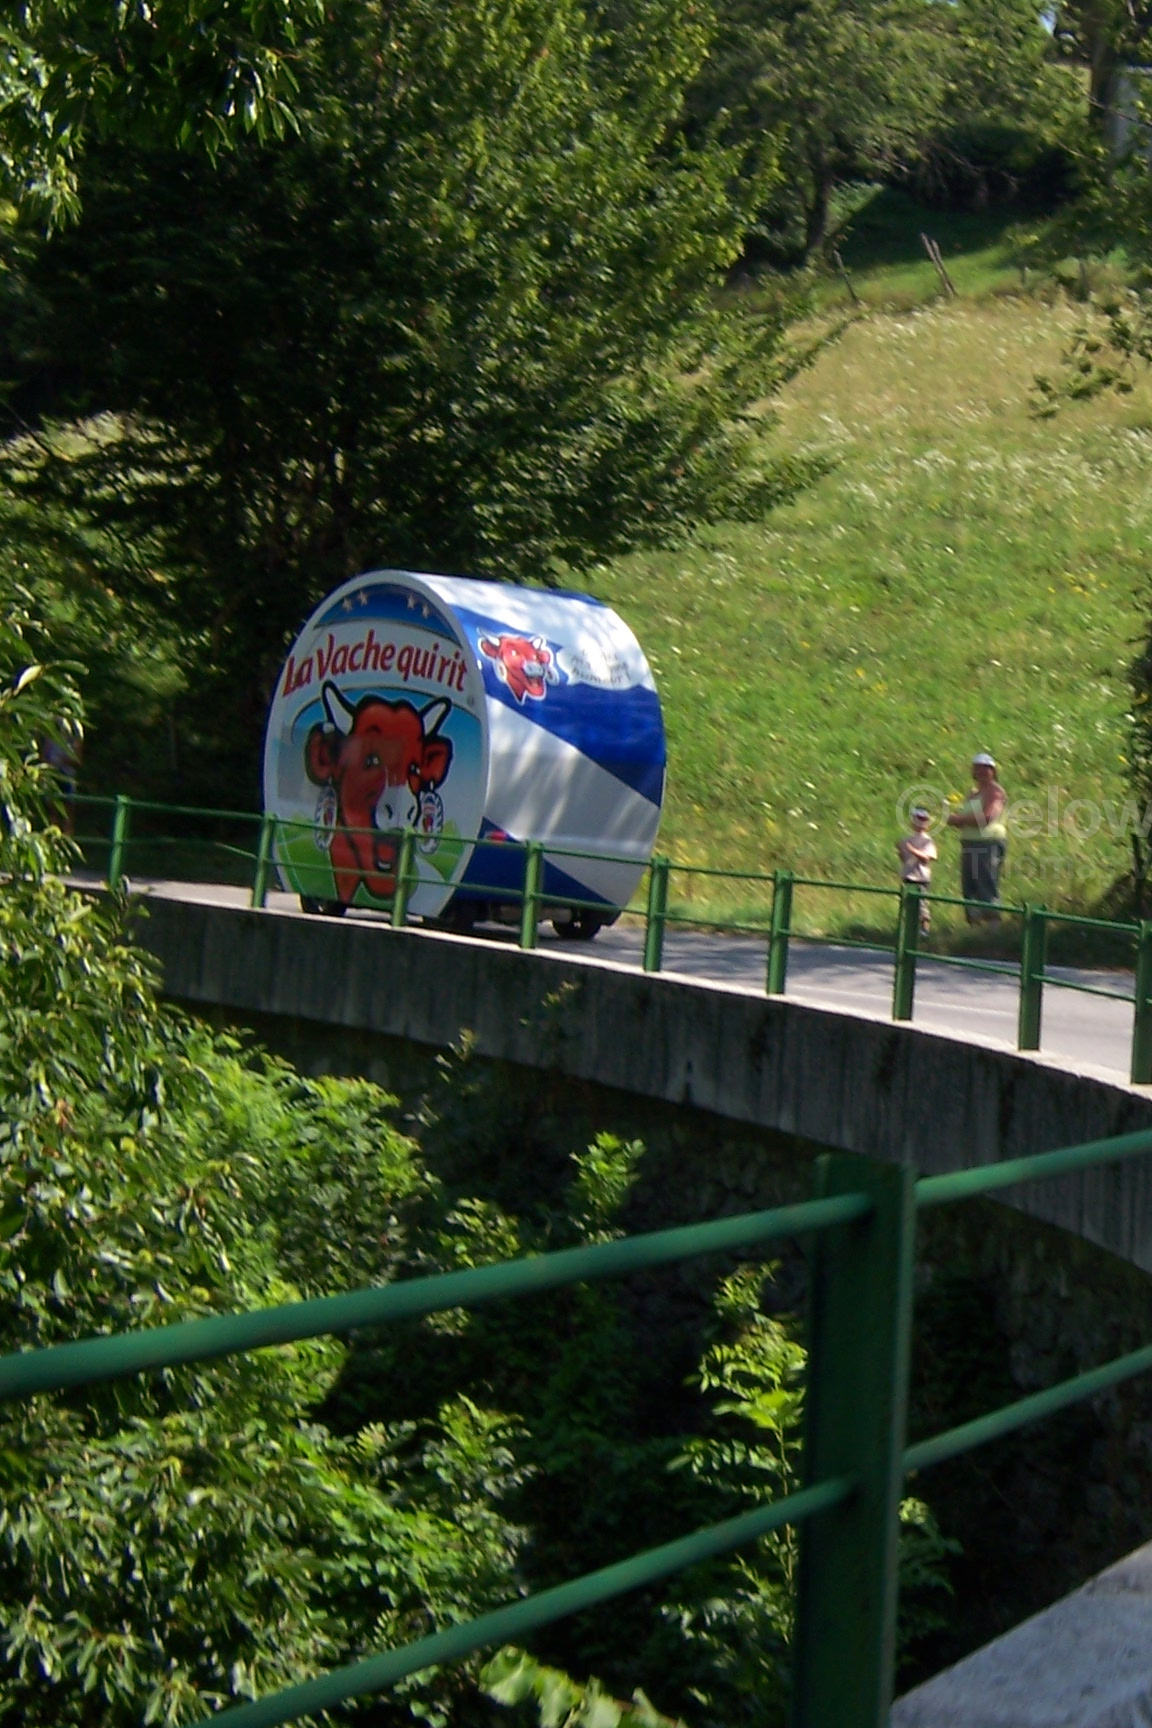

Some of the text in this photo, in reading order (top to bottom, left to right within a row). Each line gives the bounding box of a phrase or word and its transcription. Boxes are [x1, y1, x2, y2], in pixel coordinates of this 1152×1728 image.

[283, 629, 468, 697] La Vache qui rit
